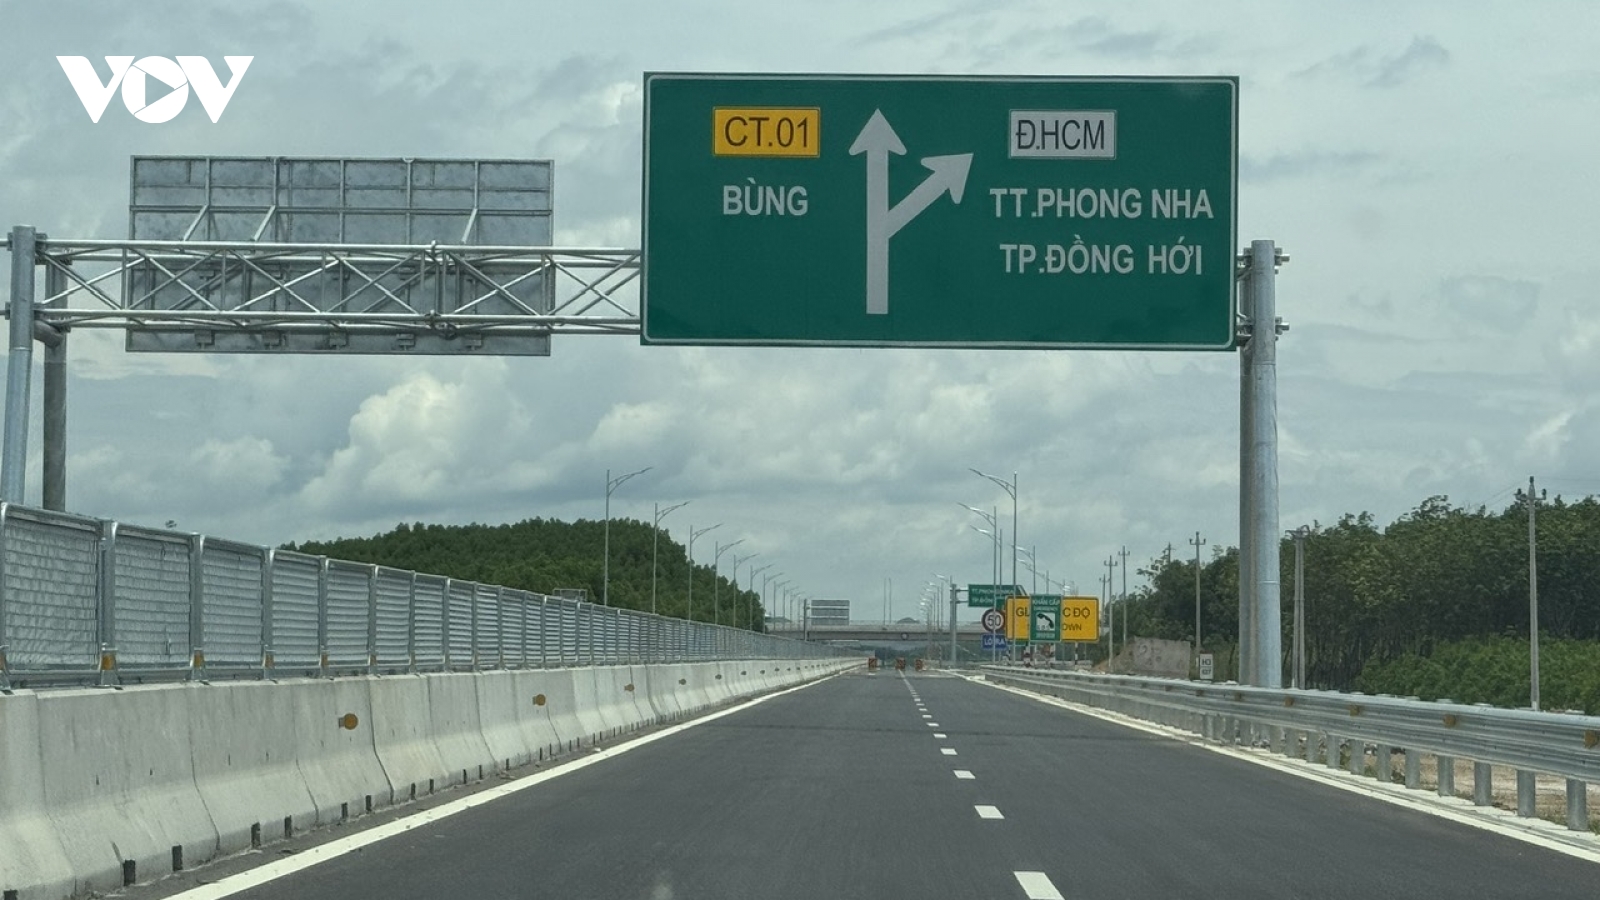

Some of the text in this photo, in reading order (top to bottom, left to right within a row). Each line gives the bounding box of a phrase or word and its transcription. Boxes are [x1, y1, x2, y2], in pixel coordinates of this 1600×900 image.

[725, 116, 807, 147] CT.01
[1016, 120, 1105, 150] Đ.HCM
[723, 177, 808, 216] BÙNG
[989, 188, 1214, 218] TT.PHONG NHA
[1000, 234, 1202, 275] TP.ĐỒNG HỚI
[988, 614, 1002, 627] 50
[1073, 606, 1091, 619] ĐỘ
